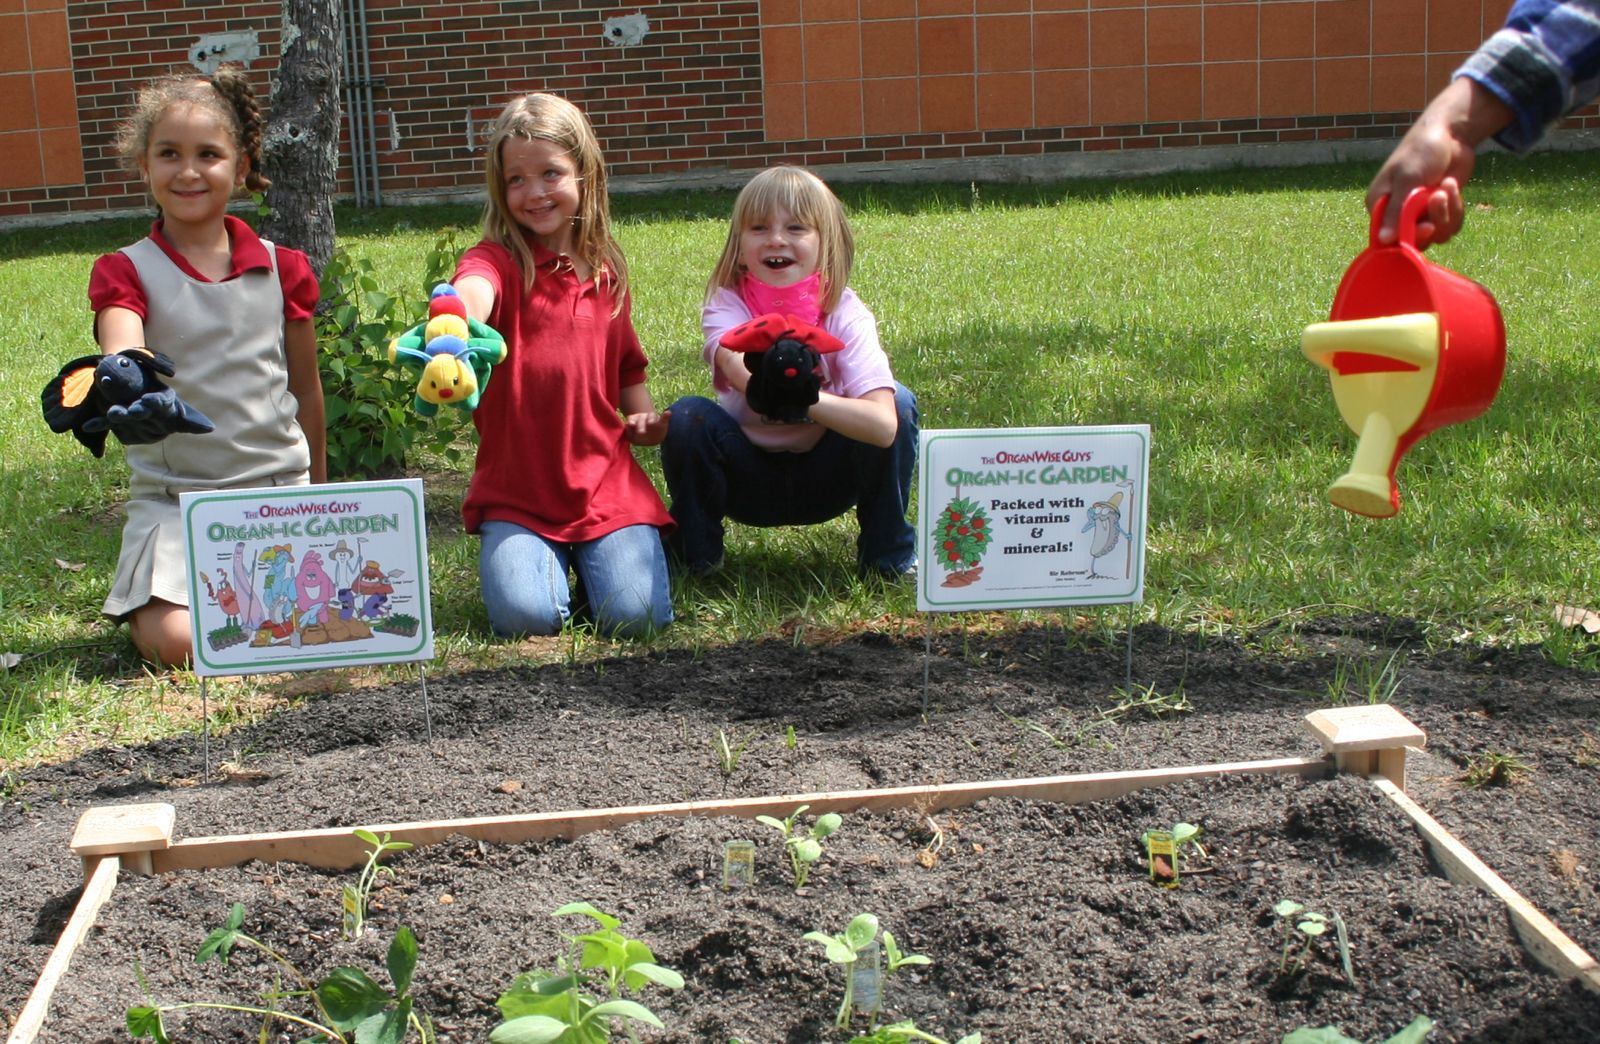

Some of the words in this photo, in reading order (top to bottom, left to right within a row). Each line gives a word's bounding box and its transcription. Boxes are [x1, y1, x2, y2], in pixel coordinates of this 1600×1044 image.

[946, 467, 1035, 487] ORGAN-IC
[1040, 465, 1128, 484] GARDEN
[991, 499, 1044, 510] Packed
[1047, 498, 1084, 510] with
[1005, 513, 1070, 525] vitamins
[207, 521, 303, 542] ORGAN-IC
[304, 514, 399, 537] GARDEN
[1030, 527, 1043, 539] &
[1003, 542, 1073, 554] minerals!
